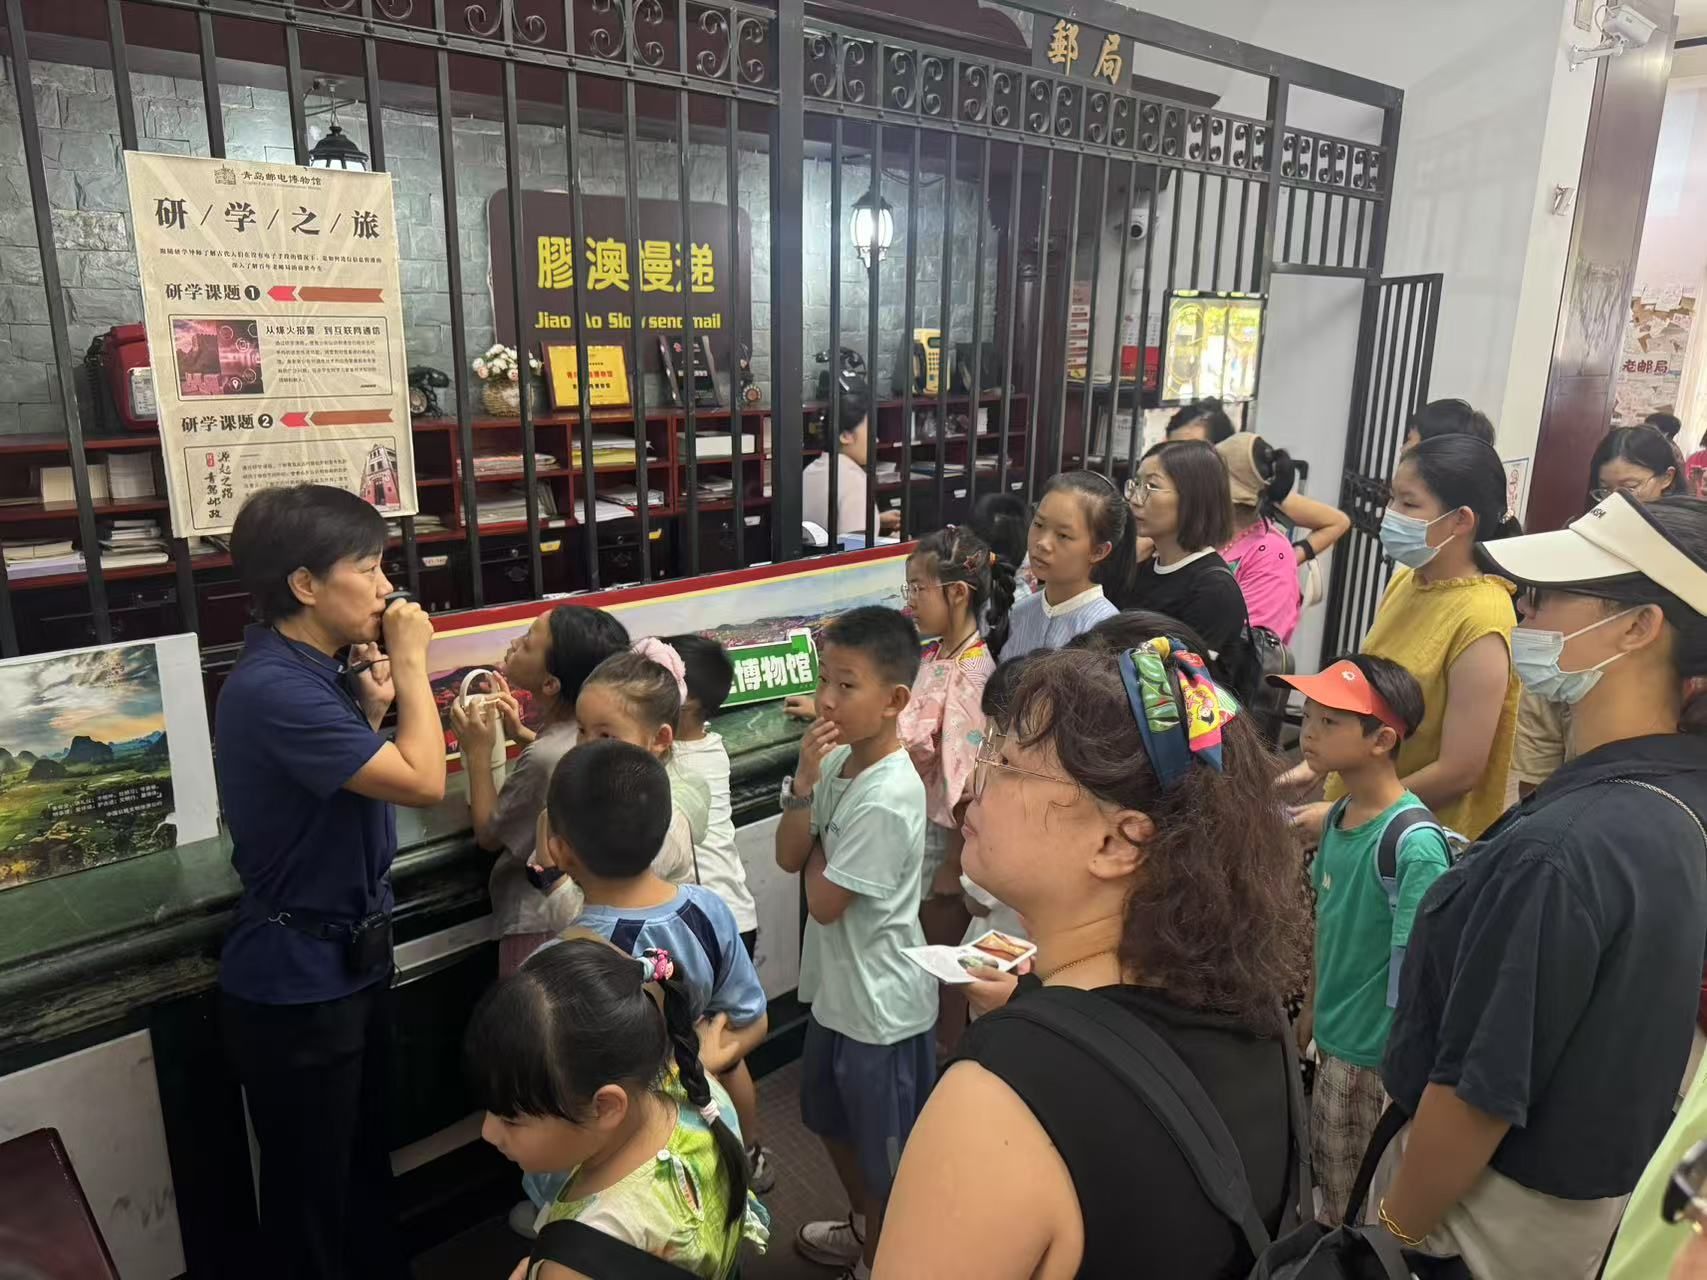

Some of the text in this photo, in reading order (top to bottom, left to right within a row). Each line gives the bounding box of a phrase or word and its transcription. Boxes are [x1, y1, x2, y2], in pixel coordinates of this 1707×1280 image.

[1047, 19, 1122, 85] 郵局
[241, 171, 322, 187] 青岛邮电博物馆
[535, 311, 572, 329] Jiao
[608, 312, 646, 329] Slo
[1622, 359, 1668, 374] 老邮局
[730, 651, 814, 695] 博物馆
